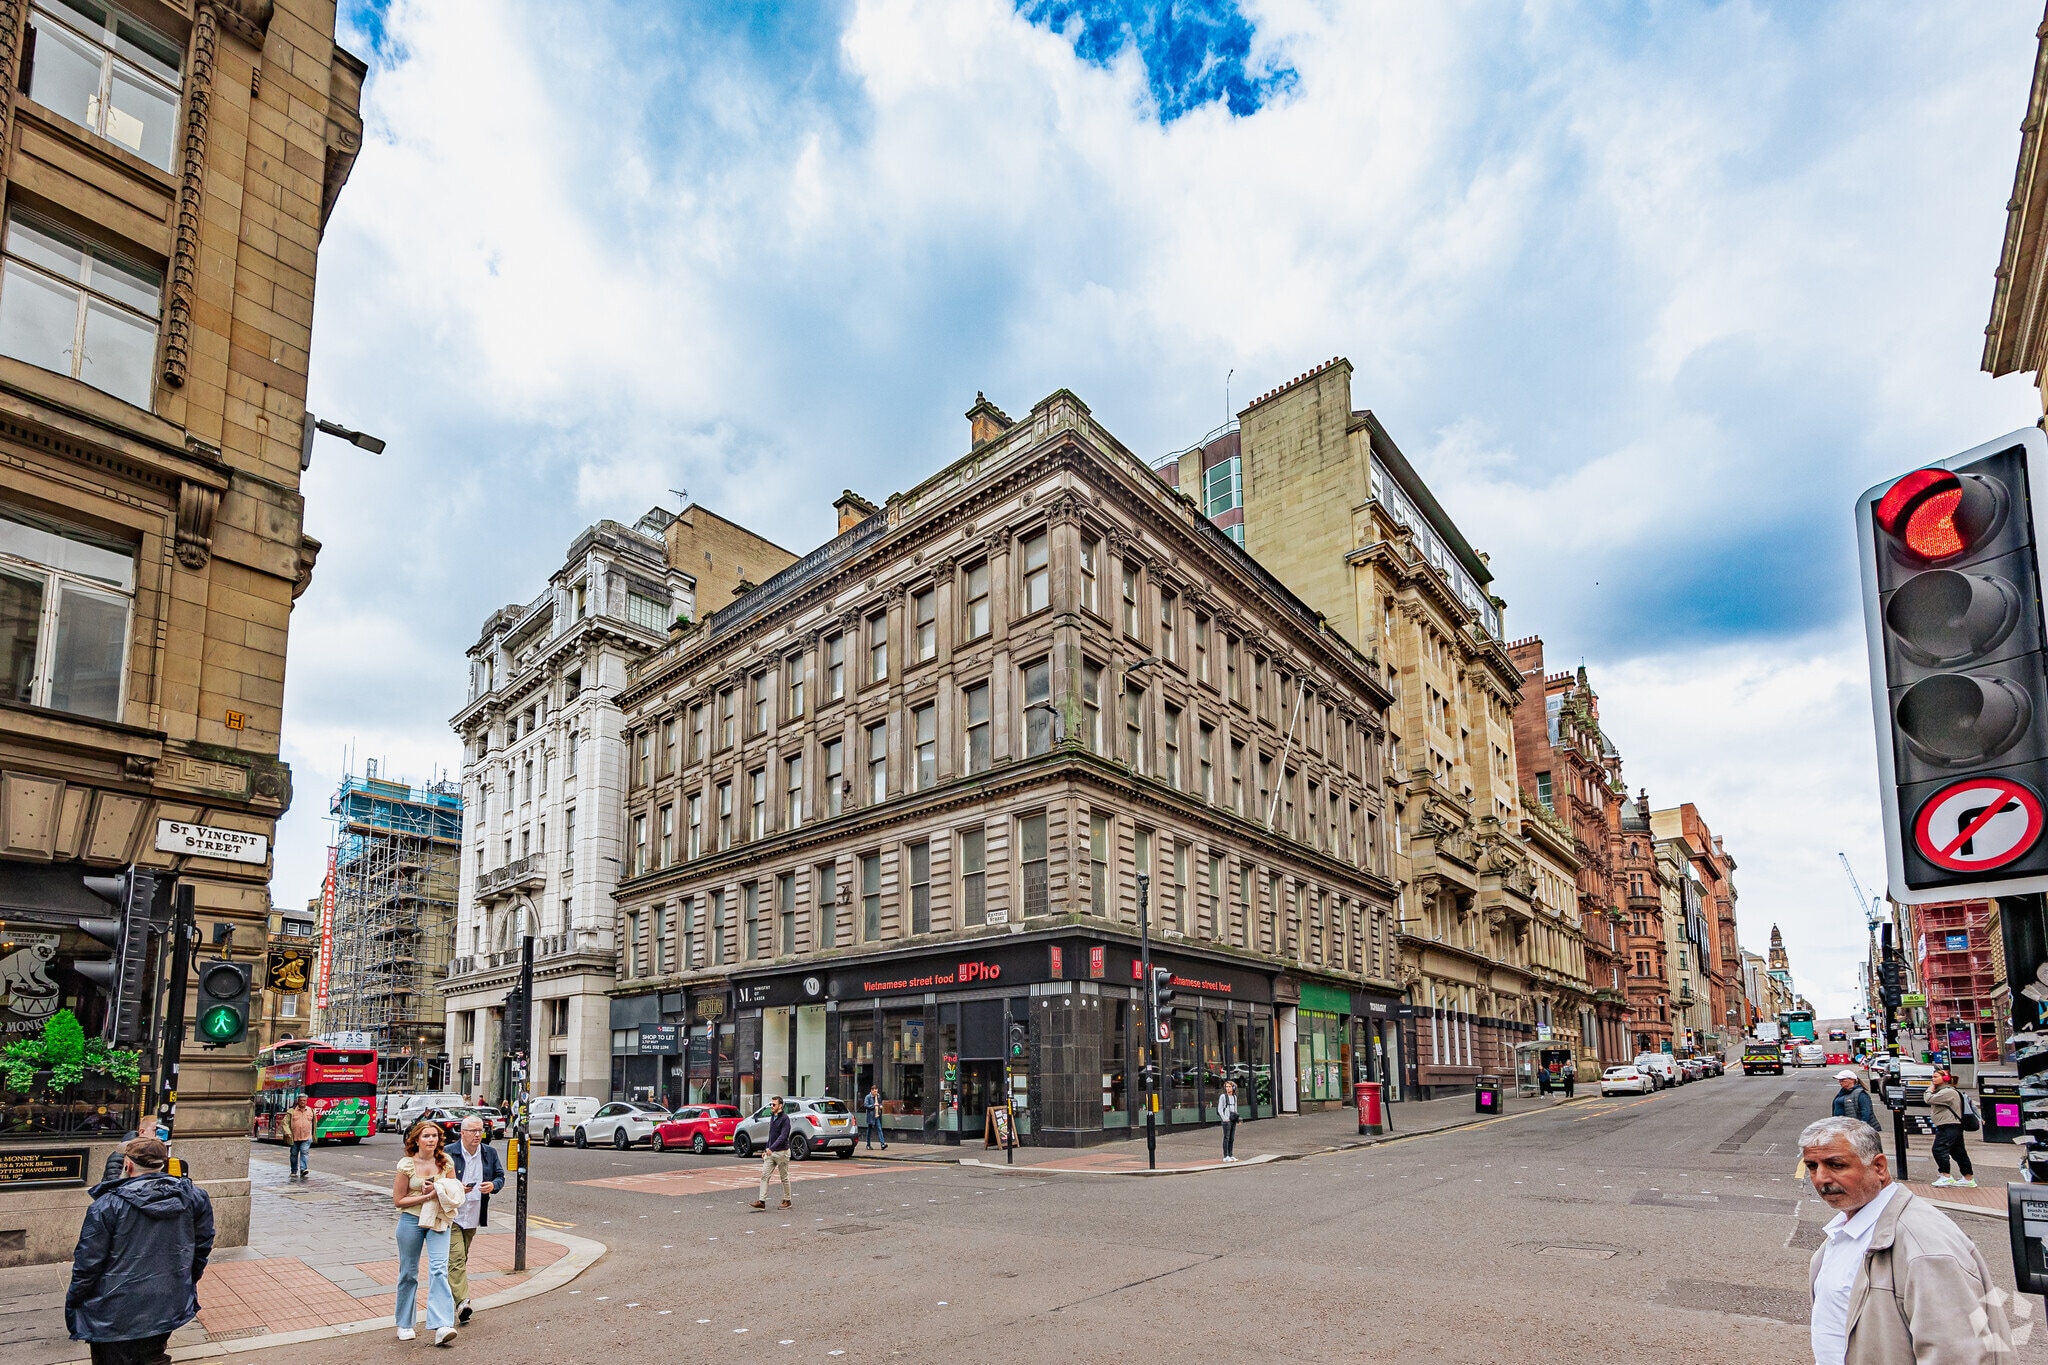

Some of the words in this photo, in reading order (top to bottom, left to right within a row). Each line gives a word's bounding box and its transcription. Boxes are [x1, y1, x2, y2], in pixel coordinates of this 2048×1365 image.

[170, 823, 189, 835] ST
[196, 827, 257, 846] VINCENT
[185, 836, 241, 854] STREET
[320, 938, 331, 996] SERVICES
[864, 978, 908, 992] Vietnamese
[909, 976, 933, 988] street
[935, 973, 954, 985] food
[968, 962, 1001, 981] Pho
[1202, 980, 1218, 991] street
[1219, 982, 1232, 993] food
[4, 1154, 40, 1163] MONKEY
[25, 1165, 68, 1173] FAVOURITES
